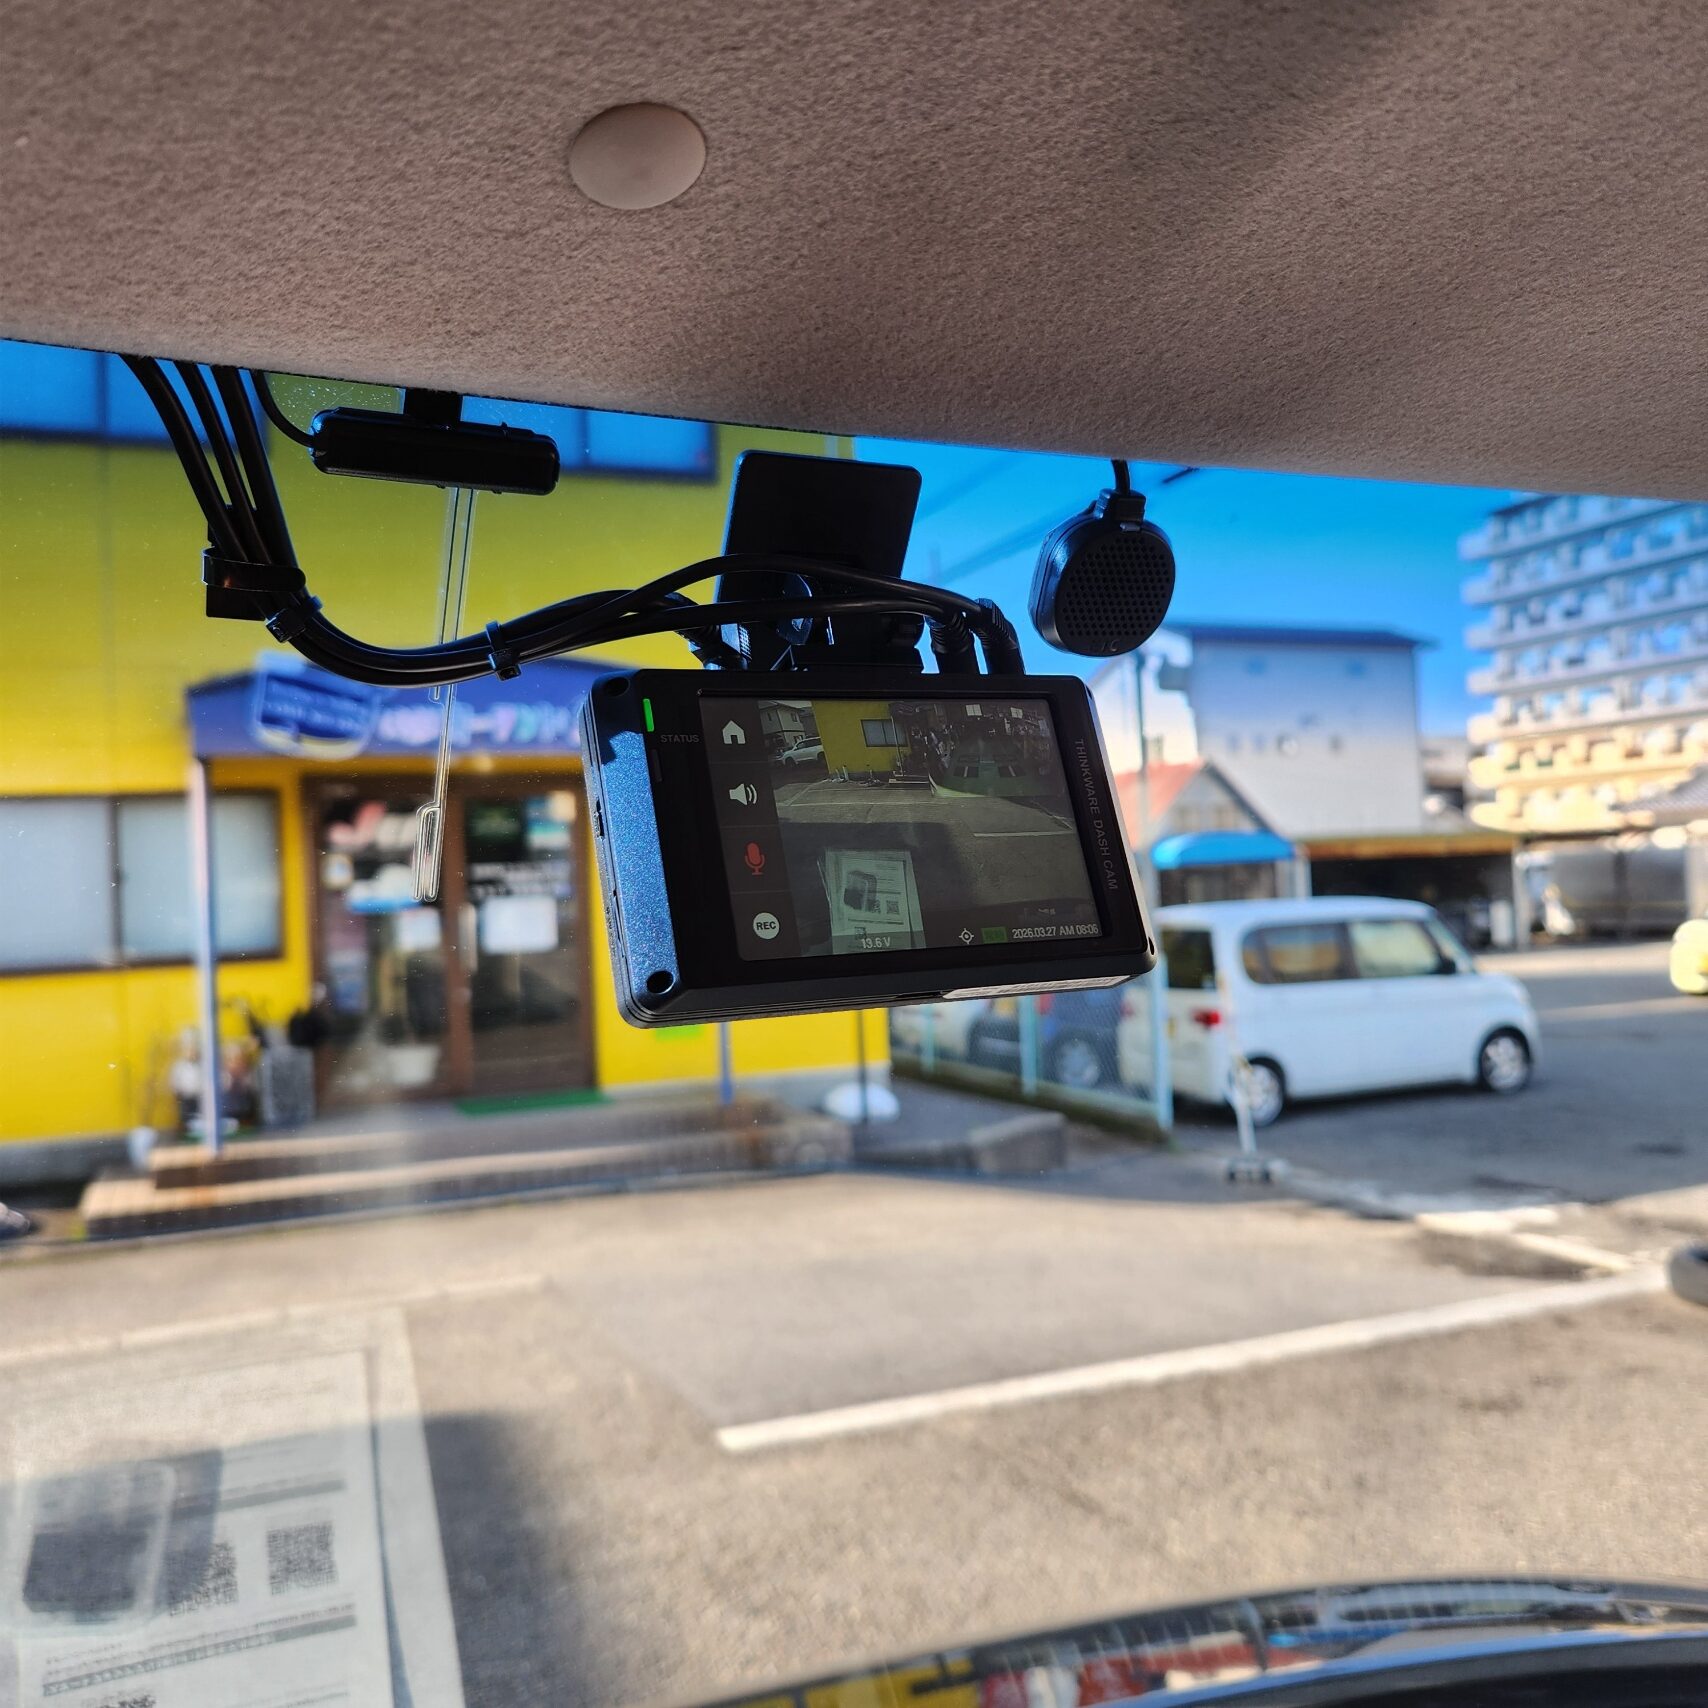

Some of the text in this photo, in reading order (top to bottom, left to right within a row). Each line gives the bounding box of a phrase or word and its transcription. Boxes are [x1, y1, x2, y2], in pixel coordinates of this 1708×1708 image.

[660, 734, 700, 743] STATUS
[1074, 738, 1119, 890] THINKWARE DASH CAM
[756, 920, 778, 931] REC
[1011, 927, 1056, 939] 2026.03.27
[1059, 925, 1075, 936] AM
[882, 936, 891, 948] V
